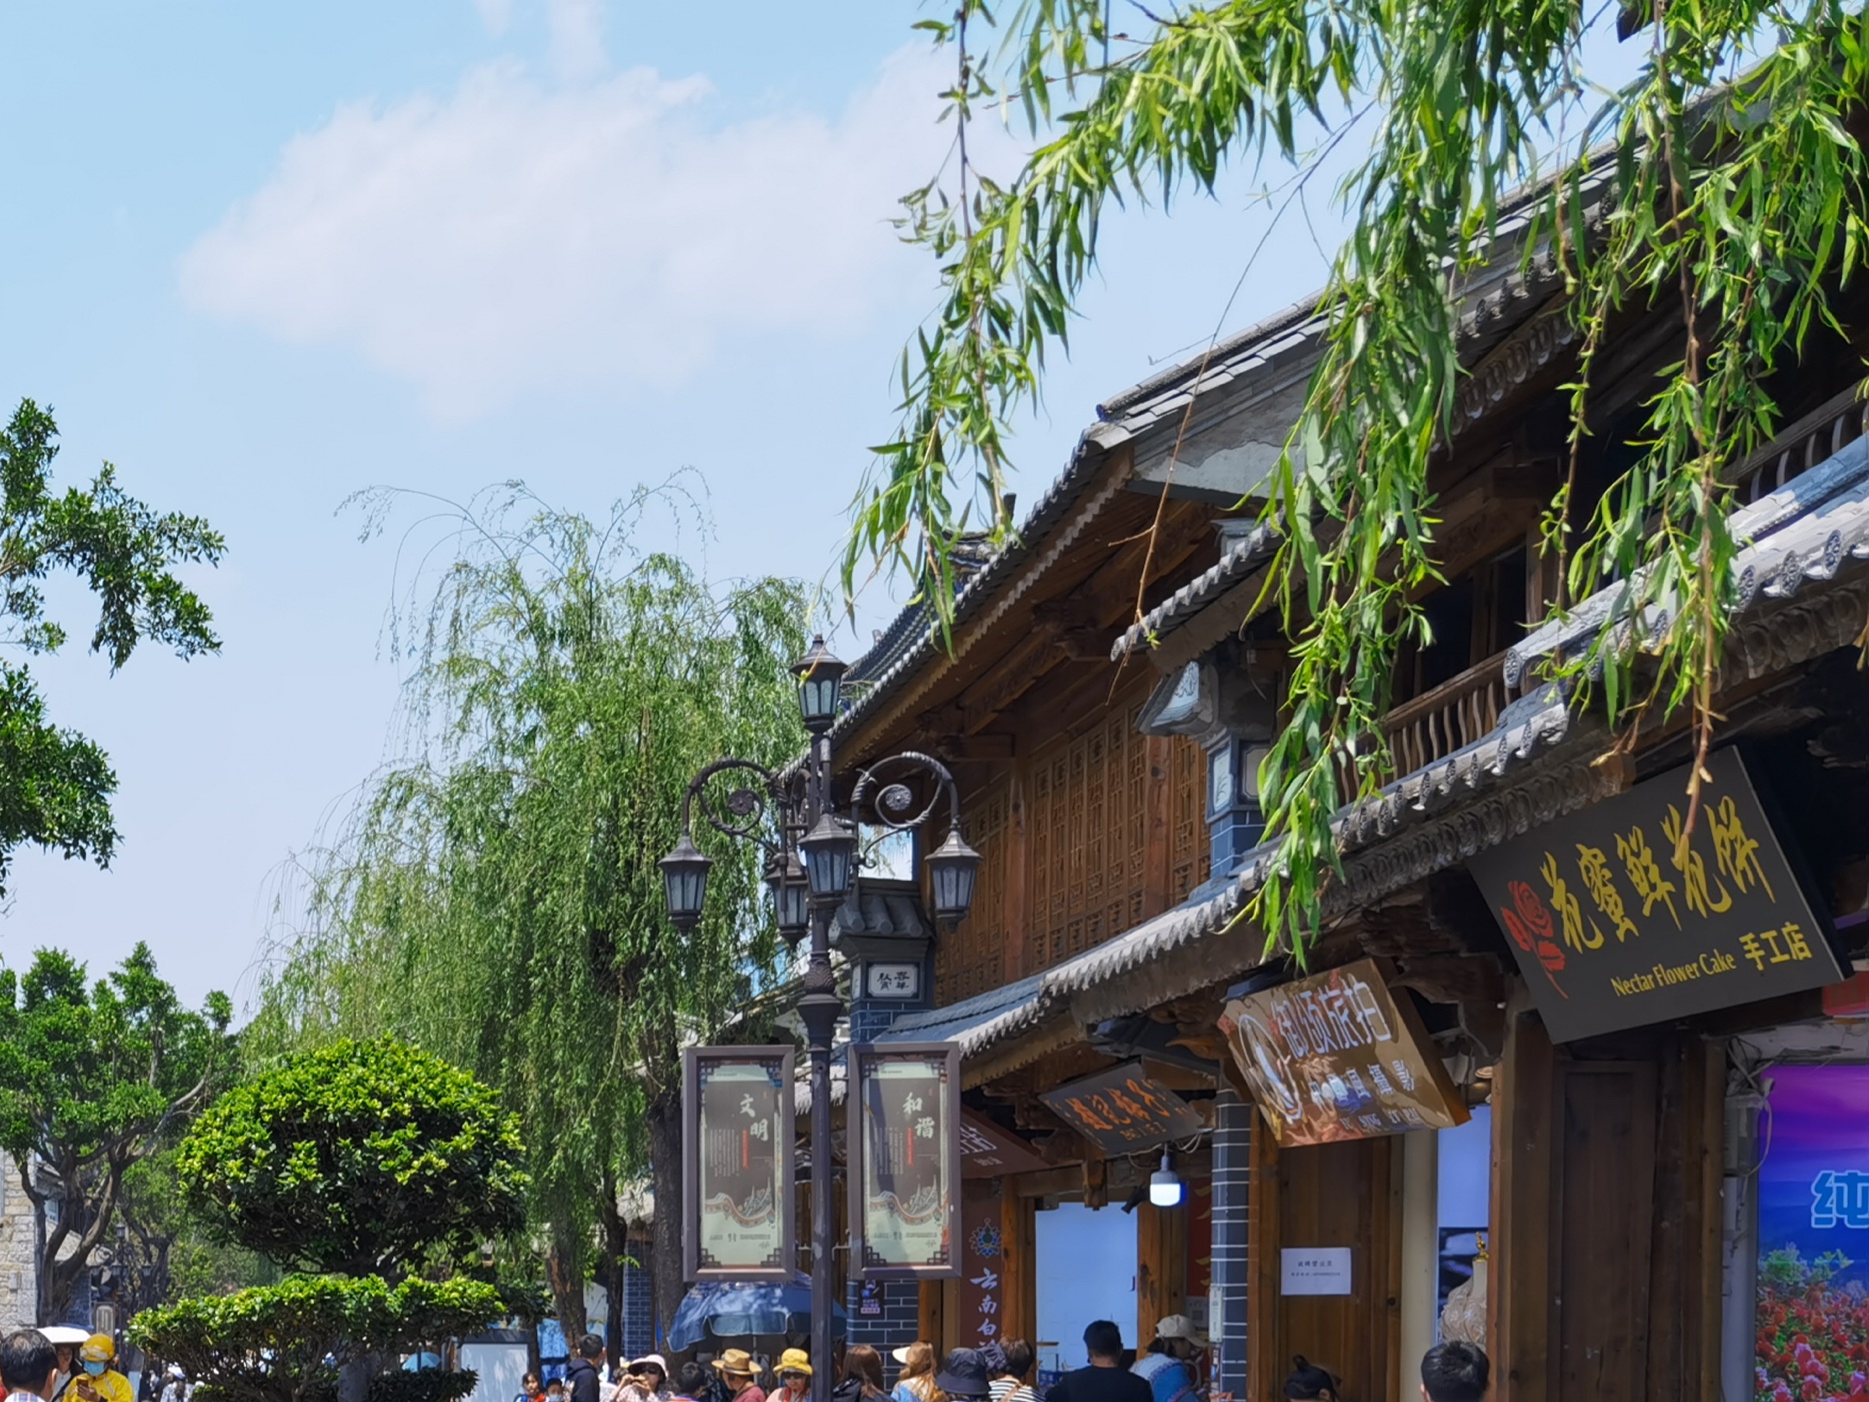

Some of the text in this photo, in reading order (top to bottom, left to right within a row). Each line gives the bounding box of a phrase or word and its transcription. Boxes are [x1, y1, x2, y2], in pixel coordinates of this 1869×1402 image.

[1739, 922, 1813, 971] 手工店
[1610, 949, 1737, 997] Nectar Flower Cake
[739, 1093, 770, 1142] 文明
[902, 1091, 936, 1139] 和谐
